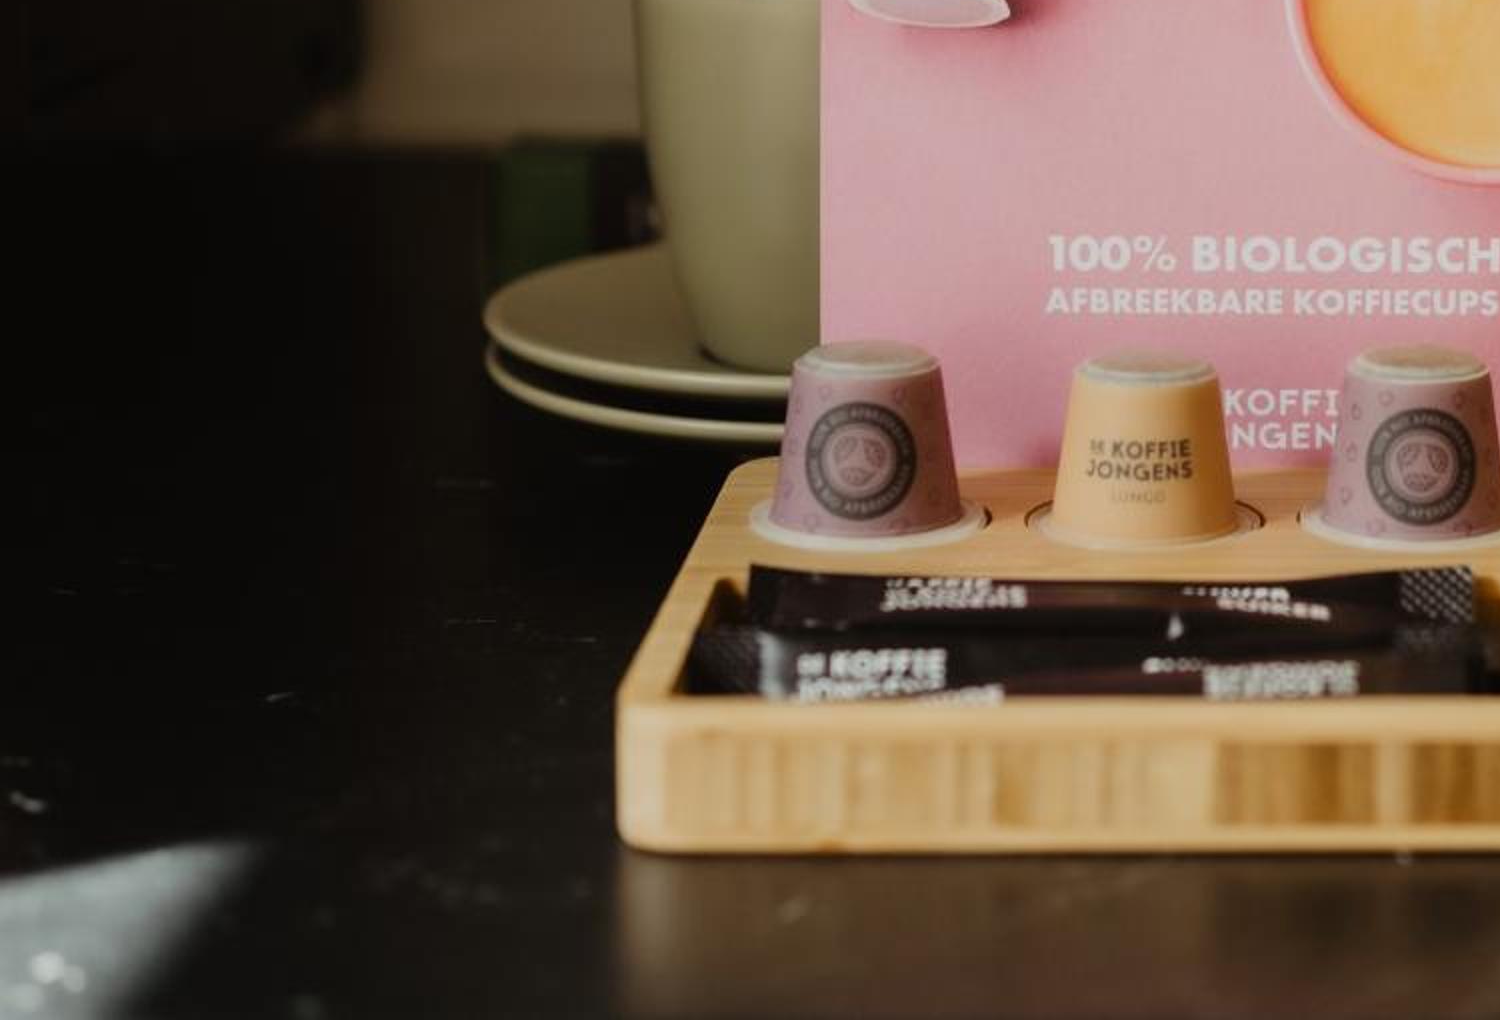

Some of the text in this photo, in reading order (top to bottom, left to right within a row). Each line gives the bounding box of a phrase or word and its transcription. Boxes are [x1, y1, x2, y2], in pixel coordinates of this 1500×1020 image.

[1047, 235, 1177, 273] 100%
[1045, 287, 1500, 317] AFBREEKBARE KOFFIECUPS
[1224, 388, 1340, 417] KOFFI
[1111, 438, 1193, 461] KOFFIE
[1231, 421, 1338, 450] NGEN
[1086, 460, 1194, 482] JONGENS
